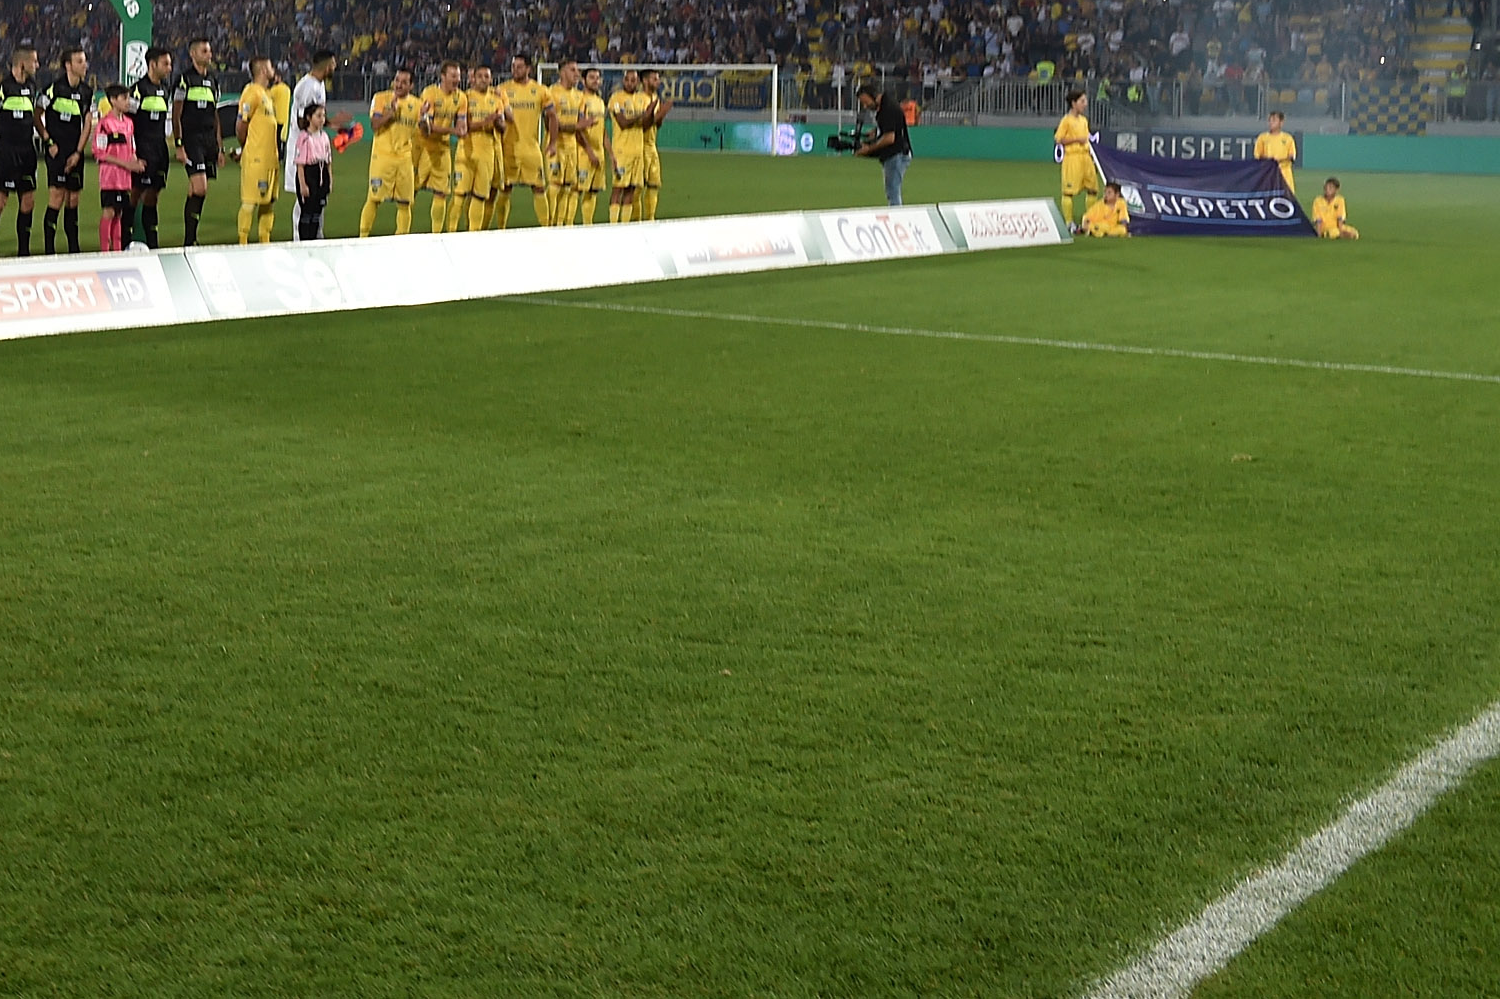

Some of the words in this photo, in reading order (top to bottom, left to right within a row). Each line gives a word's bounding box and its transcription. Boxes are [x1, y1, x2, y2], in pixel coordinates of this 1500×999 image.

[1150, 135, 1256, 161] RISPET
[1151, 192, 1295, 220] RISPETTO
[836, 214, 931, 256] ConTe.it
[988, 210, 1049, 239] Kappa
[106, 276, 144, 304] HD
